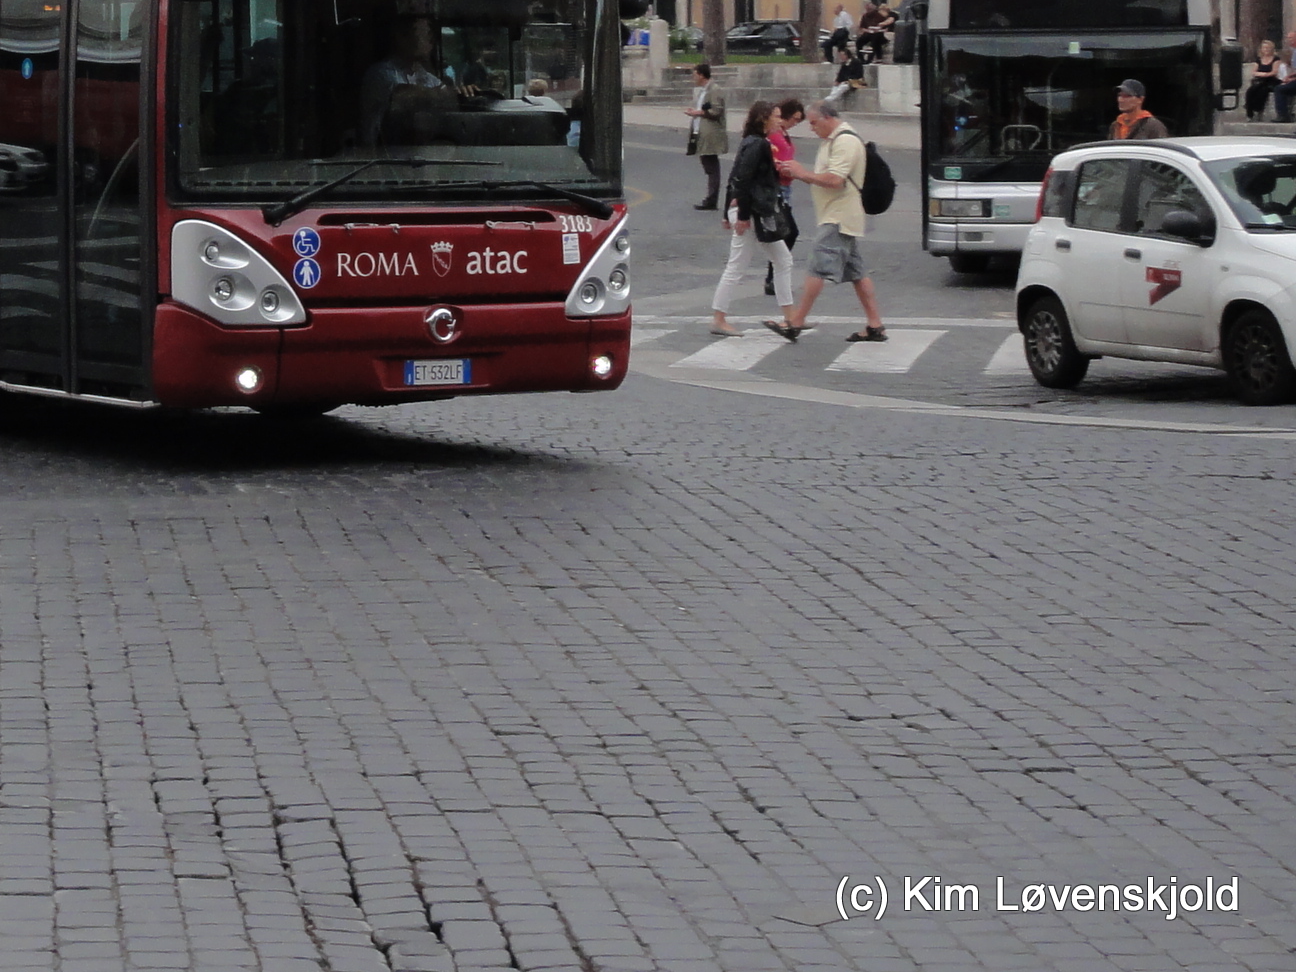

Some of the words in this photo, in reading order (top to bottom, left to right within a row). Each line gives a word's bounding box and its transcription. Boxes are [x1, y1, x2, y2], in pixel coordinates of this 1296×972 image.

[559, 214, 592, 232] 3183
[336, 252, 419, 278] ROMA
[466, 246, 528, 275] atac
